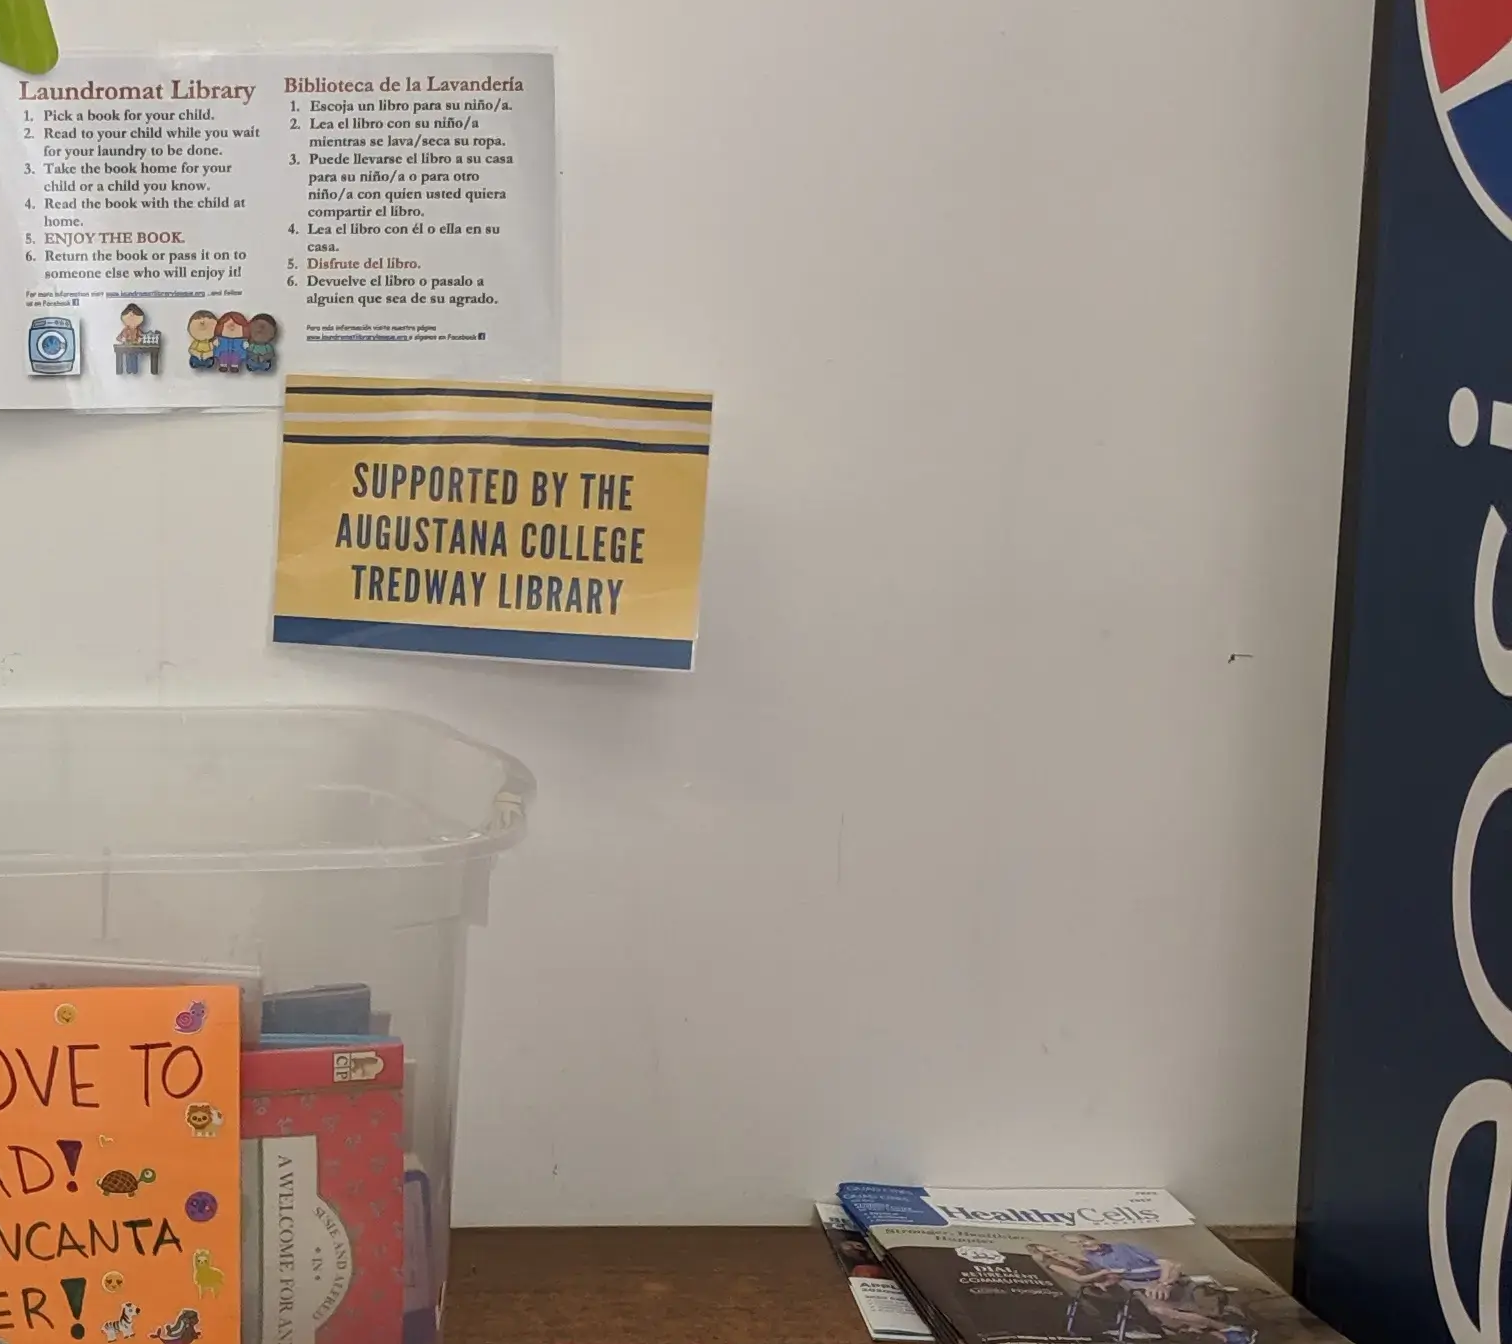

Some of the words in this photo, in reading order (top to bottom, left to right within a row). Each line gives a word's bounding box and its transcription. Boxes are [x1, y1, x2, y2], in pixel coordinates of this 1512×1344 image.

[18, 79, 164, 101] Laundromat
[170, 78, 257, 106] Library
[283, 76, 375, 94] Biblioteca
[378, 76, 401, 93] de
[405, 76, 424, 92] la
[425, 75, 525, 92] Lavandería
[309, 99, 355, 114] Escoja
[357, 102, 376, 112] un
[378, 98, 410, 112] libro
[410, 101, 443, 114] para
[445, 101, 461, 111] su
[463, 98, 513, 113] niño/a.
[23, 109, 34, 123] 1.
[43, 109, 74, 122] Pick
[75, 112, 84, 122] a
[87, 108, 121, 124] book
[123, 108, 143, 122] for
[144, 111, 176, 124] your
[178, 107, 215, 121] child.
[309, 117, 335, 130] Lea
[337, 117, 350, 130] el
[352, 116, 384, 130] libro
[386, 119, 412, 130] con
[414, 119, 430, 129] su
[433, 115, 480, 131] niño/a
[23, 127, 35, 140] 2.
[43, 125, 78, 140] Read
[80, 128, 95, 141] to
[96, 127, 129, 142] your
[129, 124, 163, 141] child
[165, 126, 202, 141] while
[203, 128, 229, 142] you
[231, 124, 261, 139] wait
[308, 135, 367, 148] mientras
[369, 137, 384, 148] se
[386, 133, 452, 149] lava/seca
[453, 137, 470, 147] su
[472, 135, 506, 149] ropa.
[43, 144, 63, 157] for
[64, 147, 95, 160] your
[96, 143, 148, 160] laundry
[150, 142, 166, 157] to
[166, 143, 184, 157] be
[186, 143, 223, 157] done.
[306, 222, 333, 235] Lea
[335, 222, 347, 235] el
[349, 222, 382, 236] libro
[383, 223, 409, 235] con
[411, 221, 424, 235] él
[426, 225, 437, 235] o
[438, 222, 463, 235] ella
[465, 225, 482, 235] en
[484, 225, 501, 235] su
[25, 232, 36, 245] 5.
[43, 231, 97, 247] ENJOY
[97, 231, 134, 245] THE
[135, 230, 186, 245] BOOK.
[25, 249, 37, 262] 6.
[44, 249, 89, 263] Return
[91, 249, 113, 262] the
[115, 248, 149, 262] book
[151, 251, 166, 261] or
[168, 251, 197, 265] pass
[200, 248, 211, 261] it
[213, 251, 230, 261] on
[233, 250, 247, 261] to
[306, 243, 340, 253] casa.
[306, 257, 361, 270] Disfrute
[363, 256, 385, 270] del
[386, 256, 422, 270] libro.
[44, 267, 102, 280] someone
[104, 266, 130, 279] else
[132, 265, 161, 281] who
[162, 265, 188, 281] will
[190, 265, 226, 282] enjoy
[227, 265, 242, 278] it!
[352, 462, 518, 505] SUPPORTED
[531, 471, 568, 508] BY
[580, 473, 635, 511] THE
[335, 512, 507, 558] AUGUSTANA
[521, 522, 646, 564] COLLEGE
[351, 564, 487, 608] TREDWAY
[498, 572, 624, 615] LIBRARY
[129, 1041, 204, 1107] TO
[278, 1154, 293, 1169] A
[278, 1172, 294, 1273] WELCOME
[335, 1242, 347, 1270] AND
[278, 1279, 294, 1313] FOR
